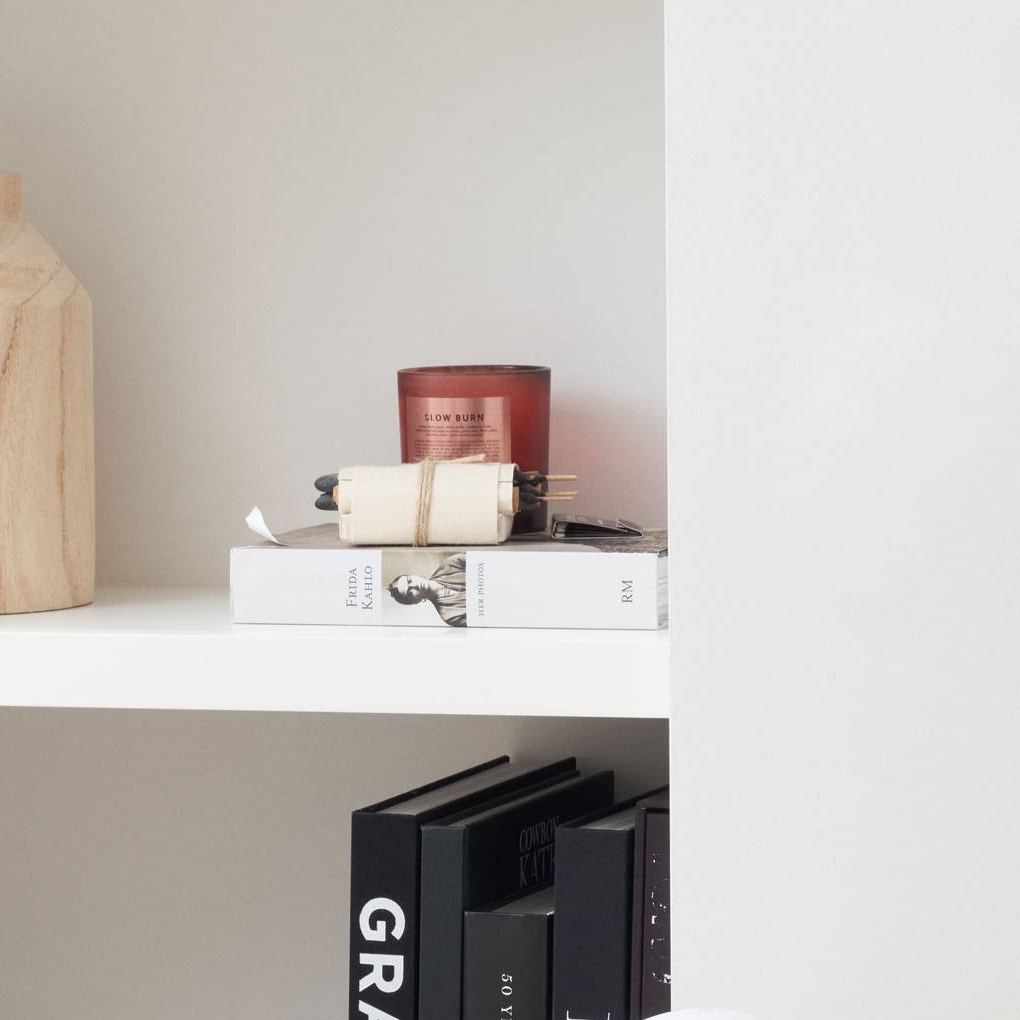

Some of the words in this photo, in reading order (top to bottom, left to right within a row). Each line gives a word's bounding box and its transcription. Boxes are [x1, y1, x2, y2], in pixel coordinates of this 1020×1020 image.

[346, 568, 357, 607] FRIDA
[362, 566, 373, 610] KAHLO
[621, 580, 633, 602] RM
[500, 973, 513, 996] 50
